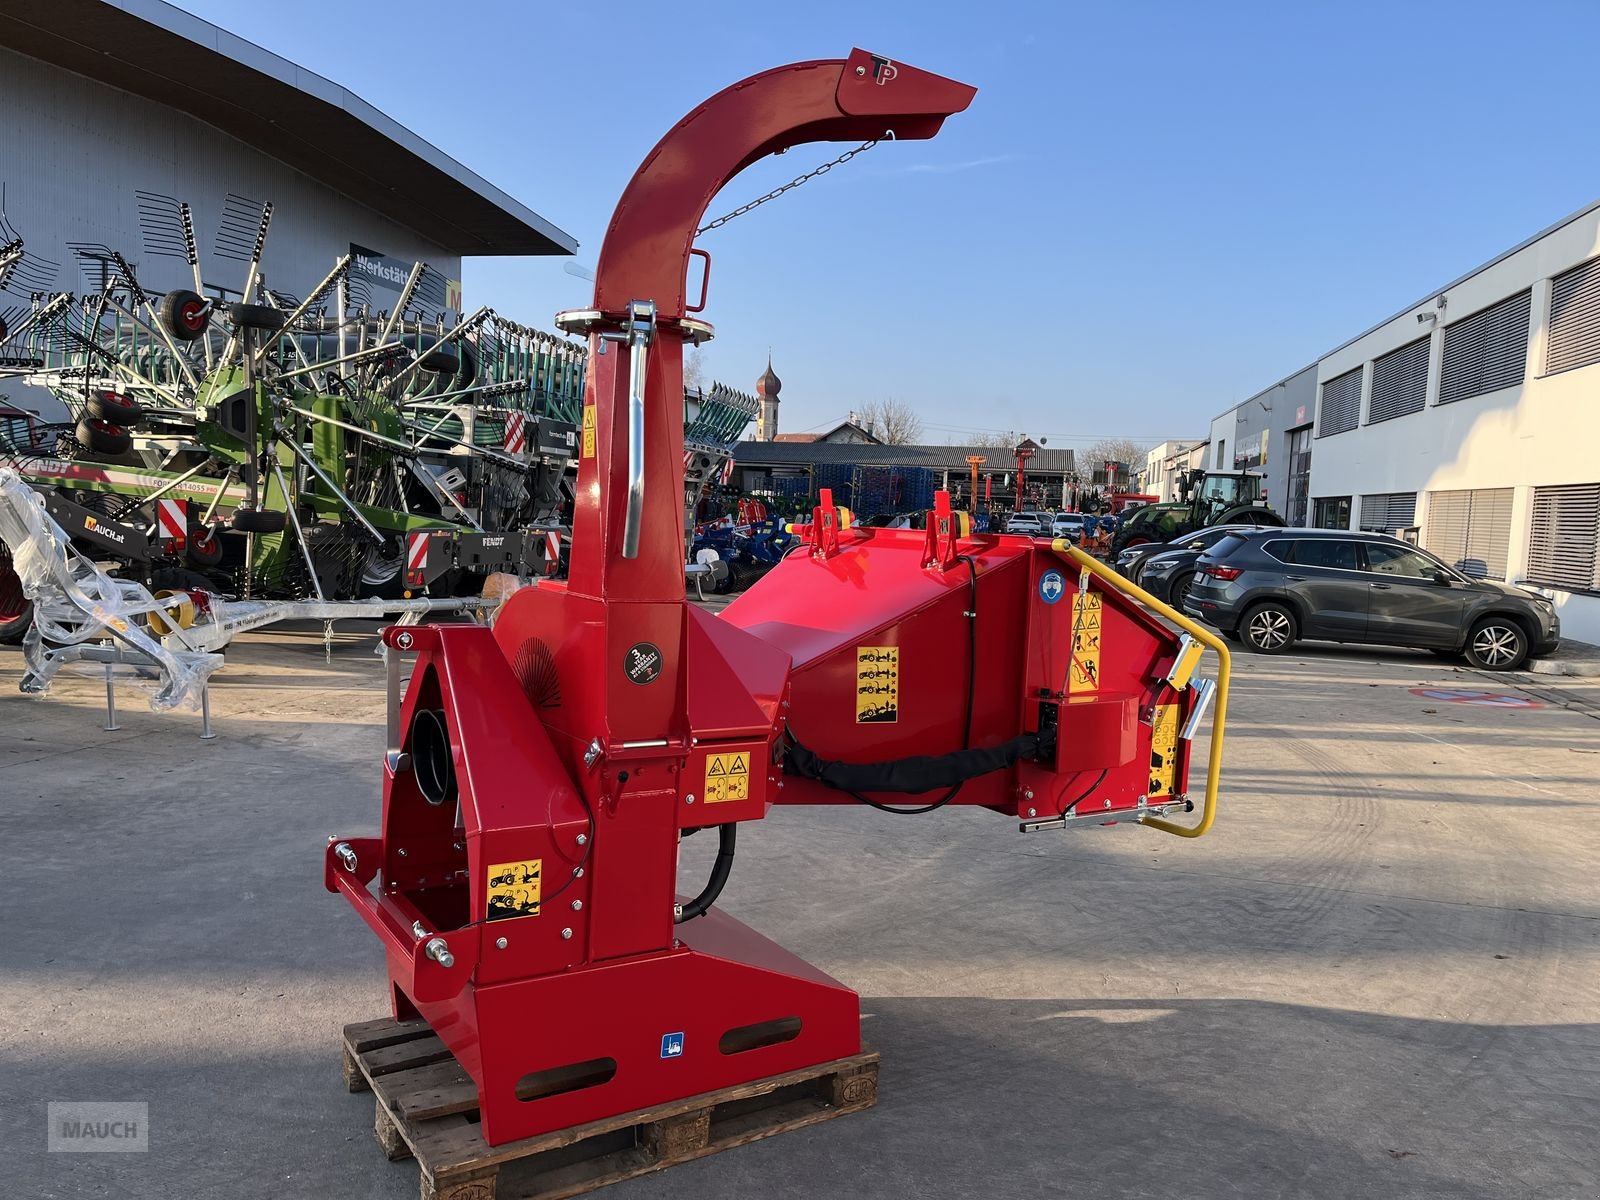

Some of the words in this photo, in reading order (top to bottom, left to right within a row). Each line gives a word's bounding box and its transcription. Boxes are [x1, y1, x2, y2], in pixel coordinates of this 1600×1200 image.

[871, 54, 898, 86] TP
[356, 253, 415, 288] Werkstätt
[86, 519, 125, 544] MAUCH.at
[482, 537, 505, 547] FENDT
[631, 648, 641, 660] 3
